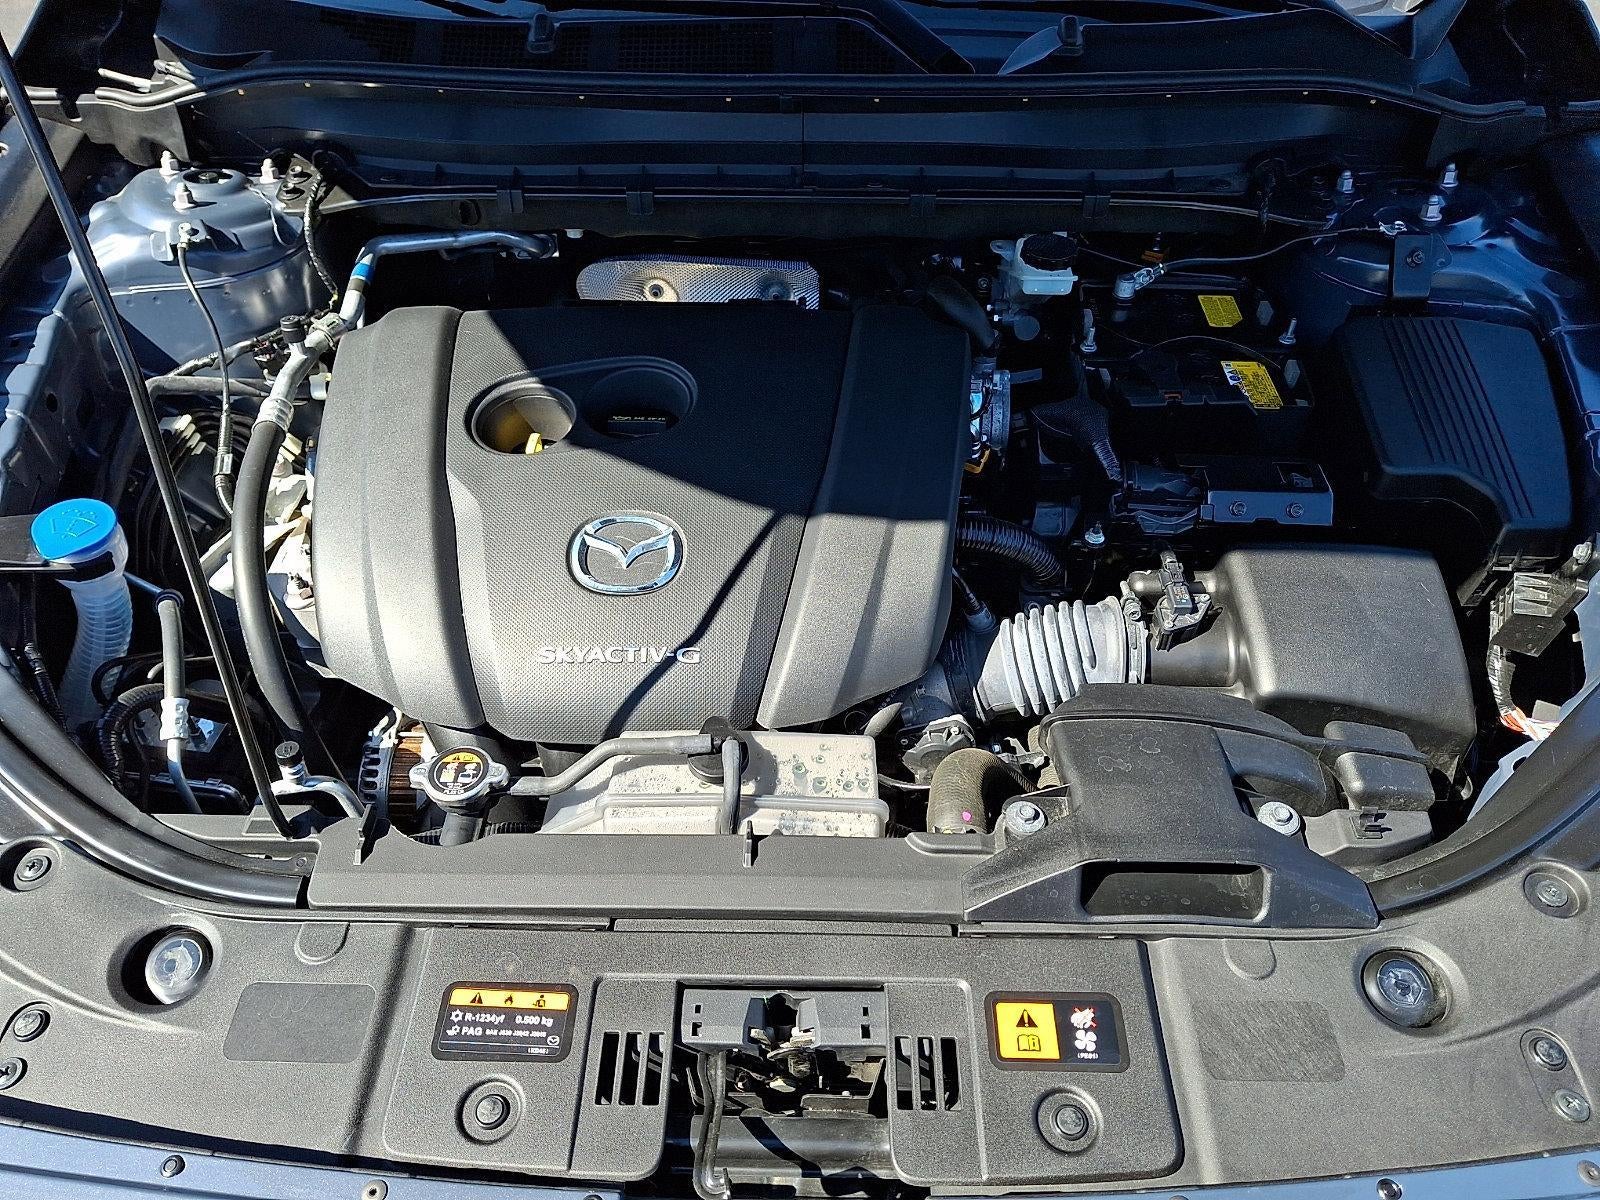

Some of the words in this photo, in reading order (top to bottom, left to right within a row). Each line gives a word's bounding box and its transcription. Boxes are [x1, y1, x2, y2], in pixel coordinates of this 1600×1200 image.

[539, 646, 701, 664] SKYACTIV-G
[464, 1012, 506, 1025] R-1234yf
[515, 1015, 541, 1025] 0.500
[541, 1016, 554, 1028] kg
[461, 1026, 483, 1036] PAG
